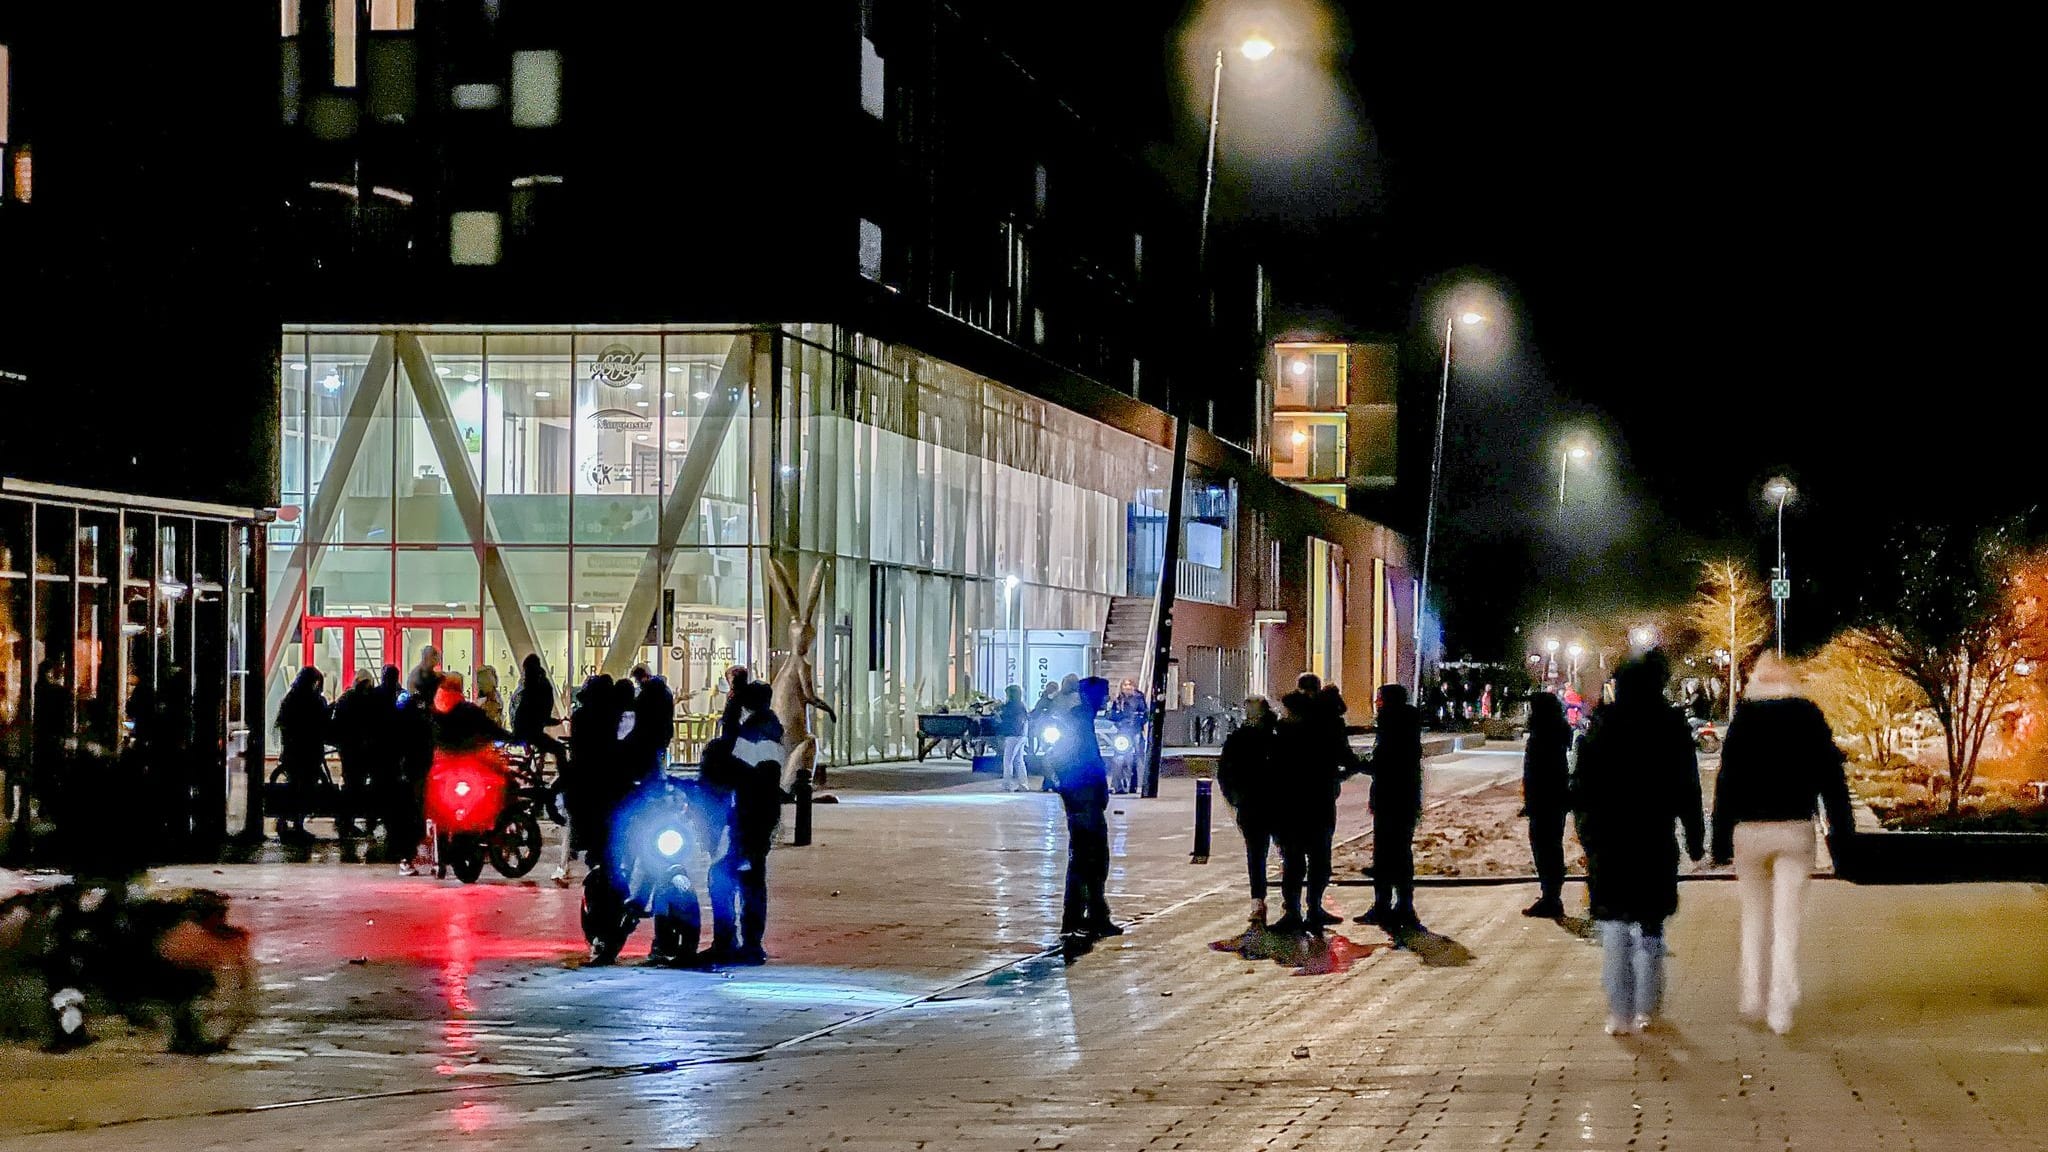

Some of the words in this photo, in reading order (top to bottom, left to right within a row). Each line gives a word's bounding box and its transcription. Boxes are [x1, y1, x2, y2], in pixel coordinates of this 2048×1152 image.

[461, 649, 466, 660] 3
[501, 649, 507, 660] 5
[1039, 657, 1048, 671] 20
